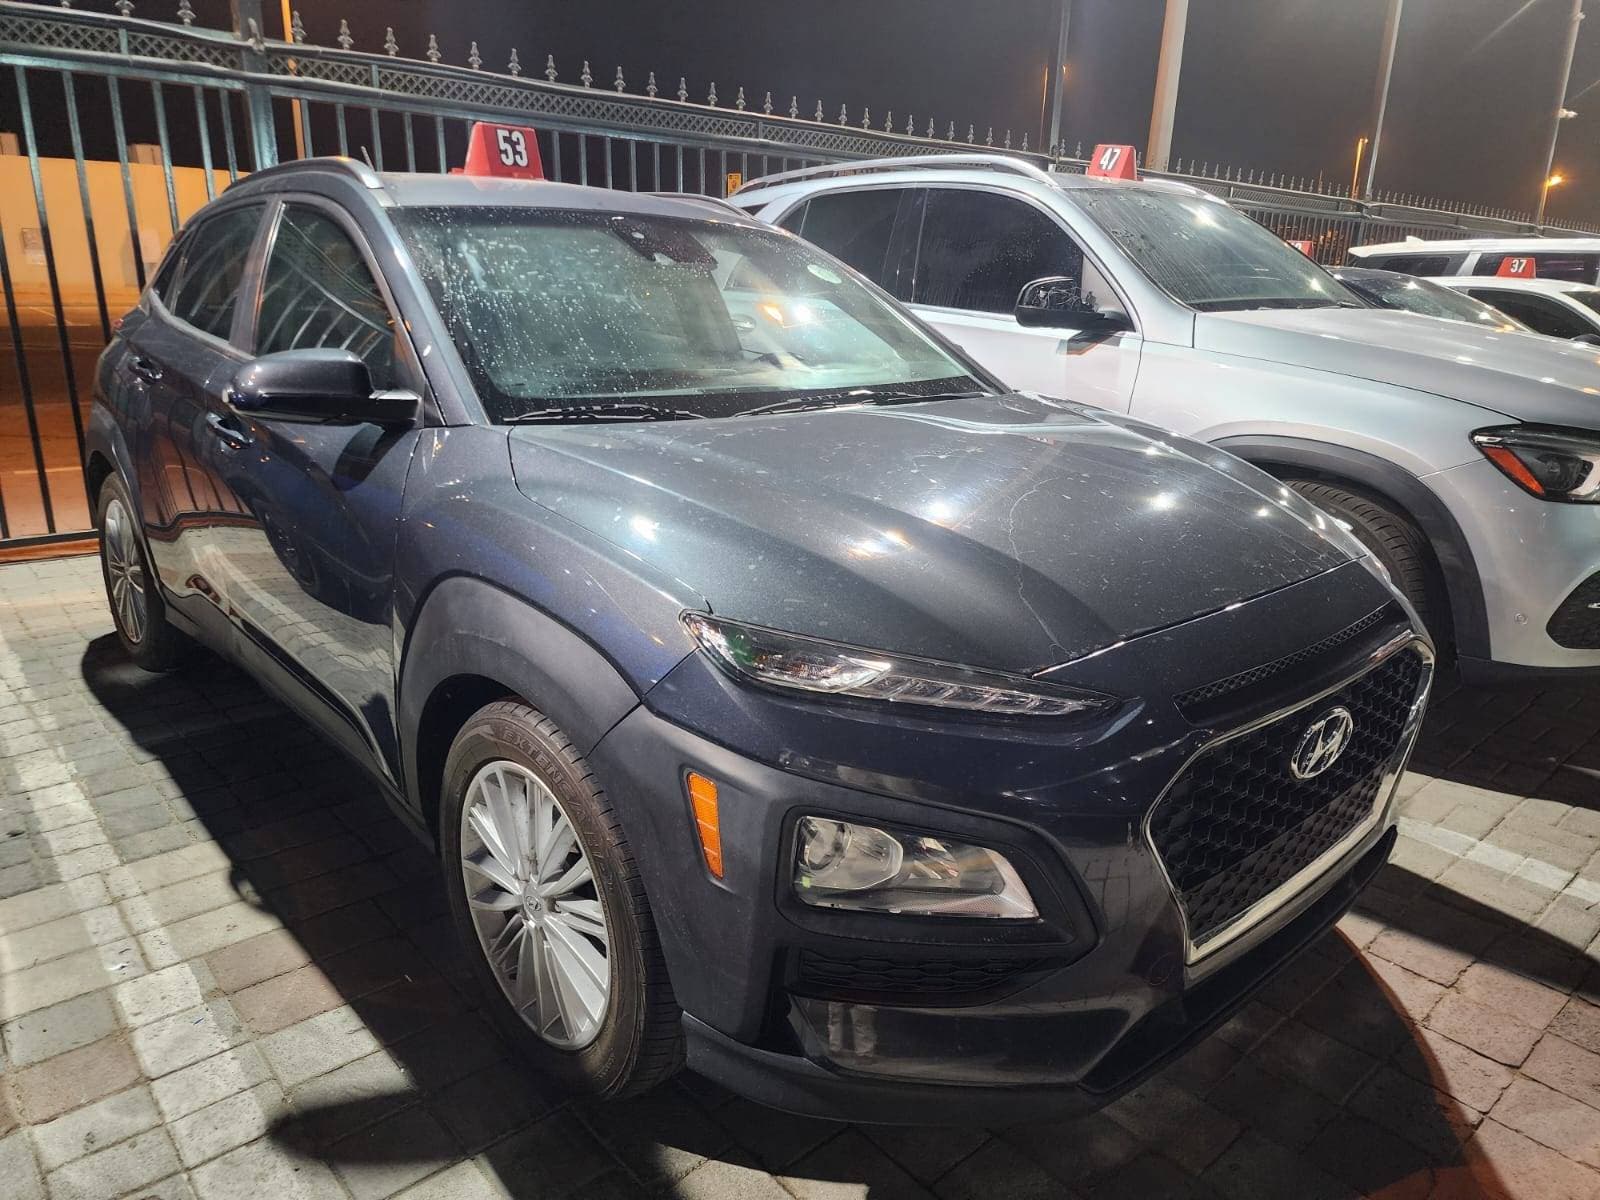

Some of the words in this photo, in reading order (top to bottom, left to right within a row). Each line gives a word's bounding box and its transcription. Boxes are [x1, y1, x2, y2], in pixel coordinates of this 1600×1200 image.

[496, 128, 528, 167] 53
[1099, 147, 1121, 170] 47
[1510, 259, 1527, 273] 37
